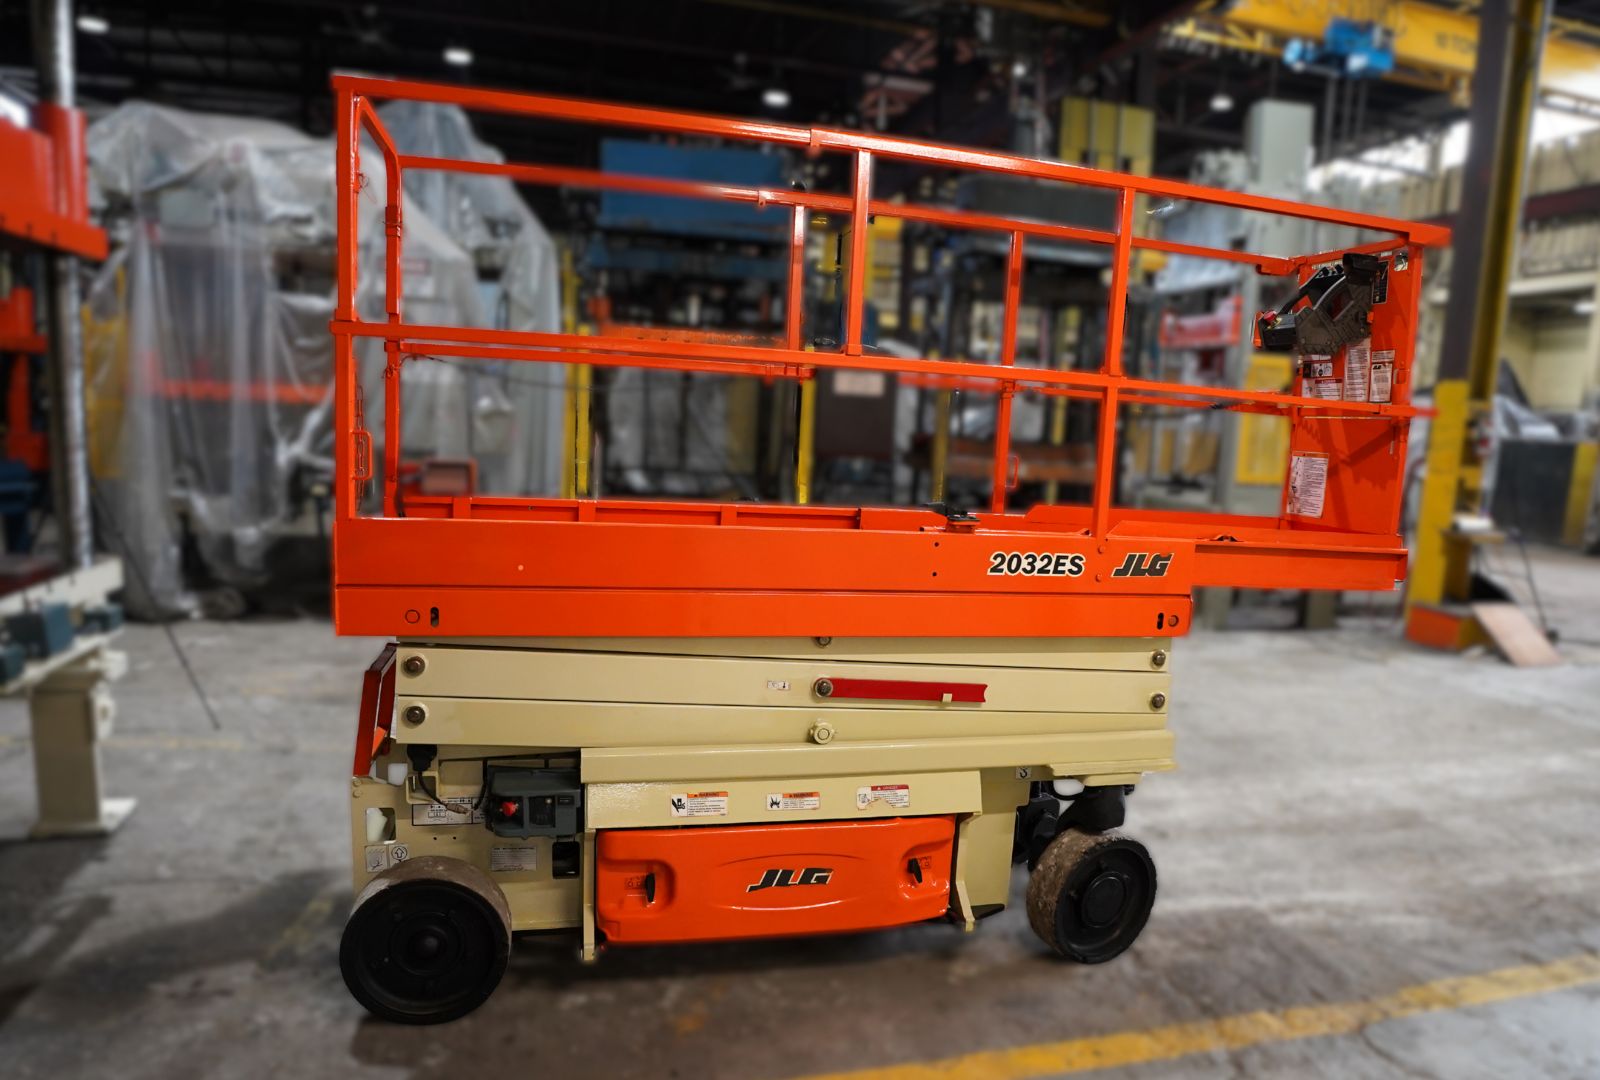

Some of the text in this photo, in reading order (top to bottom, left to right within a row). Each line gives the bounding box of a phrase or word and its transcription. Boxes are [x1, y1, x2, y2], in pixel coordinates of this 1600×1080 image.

[987, 552, 1086, 577] 2032ES
[1111, 553, 1174, 577] JLG
[745, 868, 833, 892] JLG
